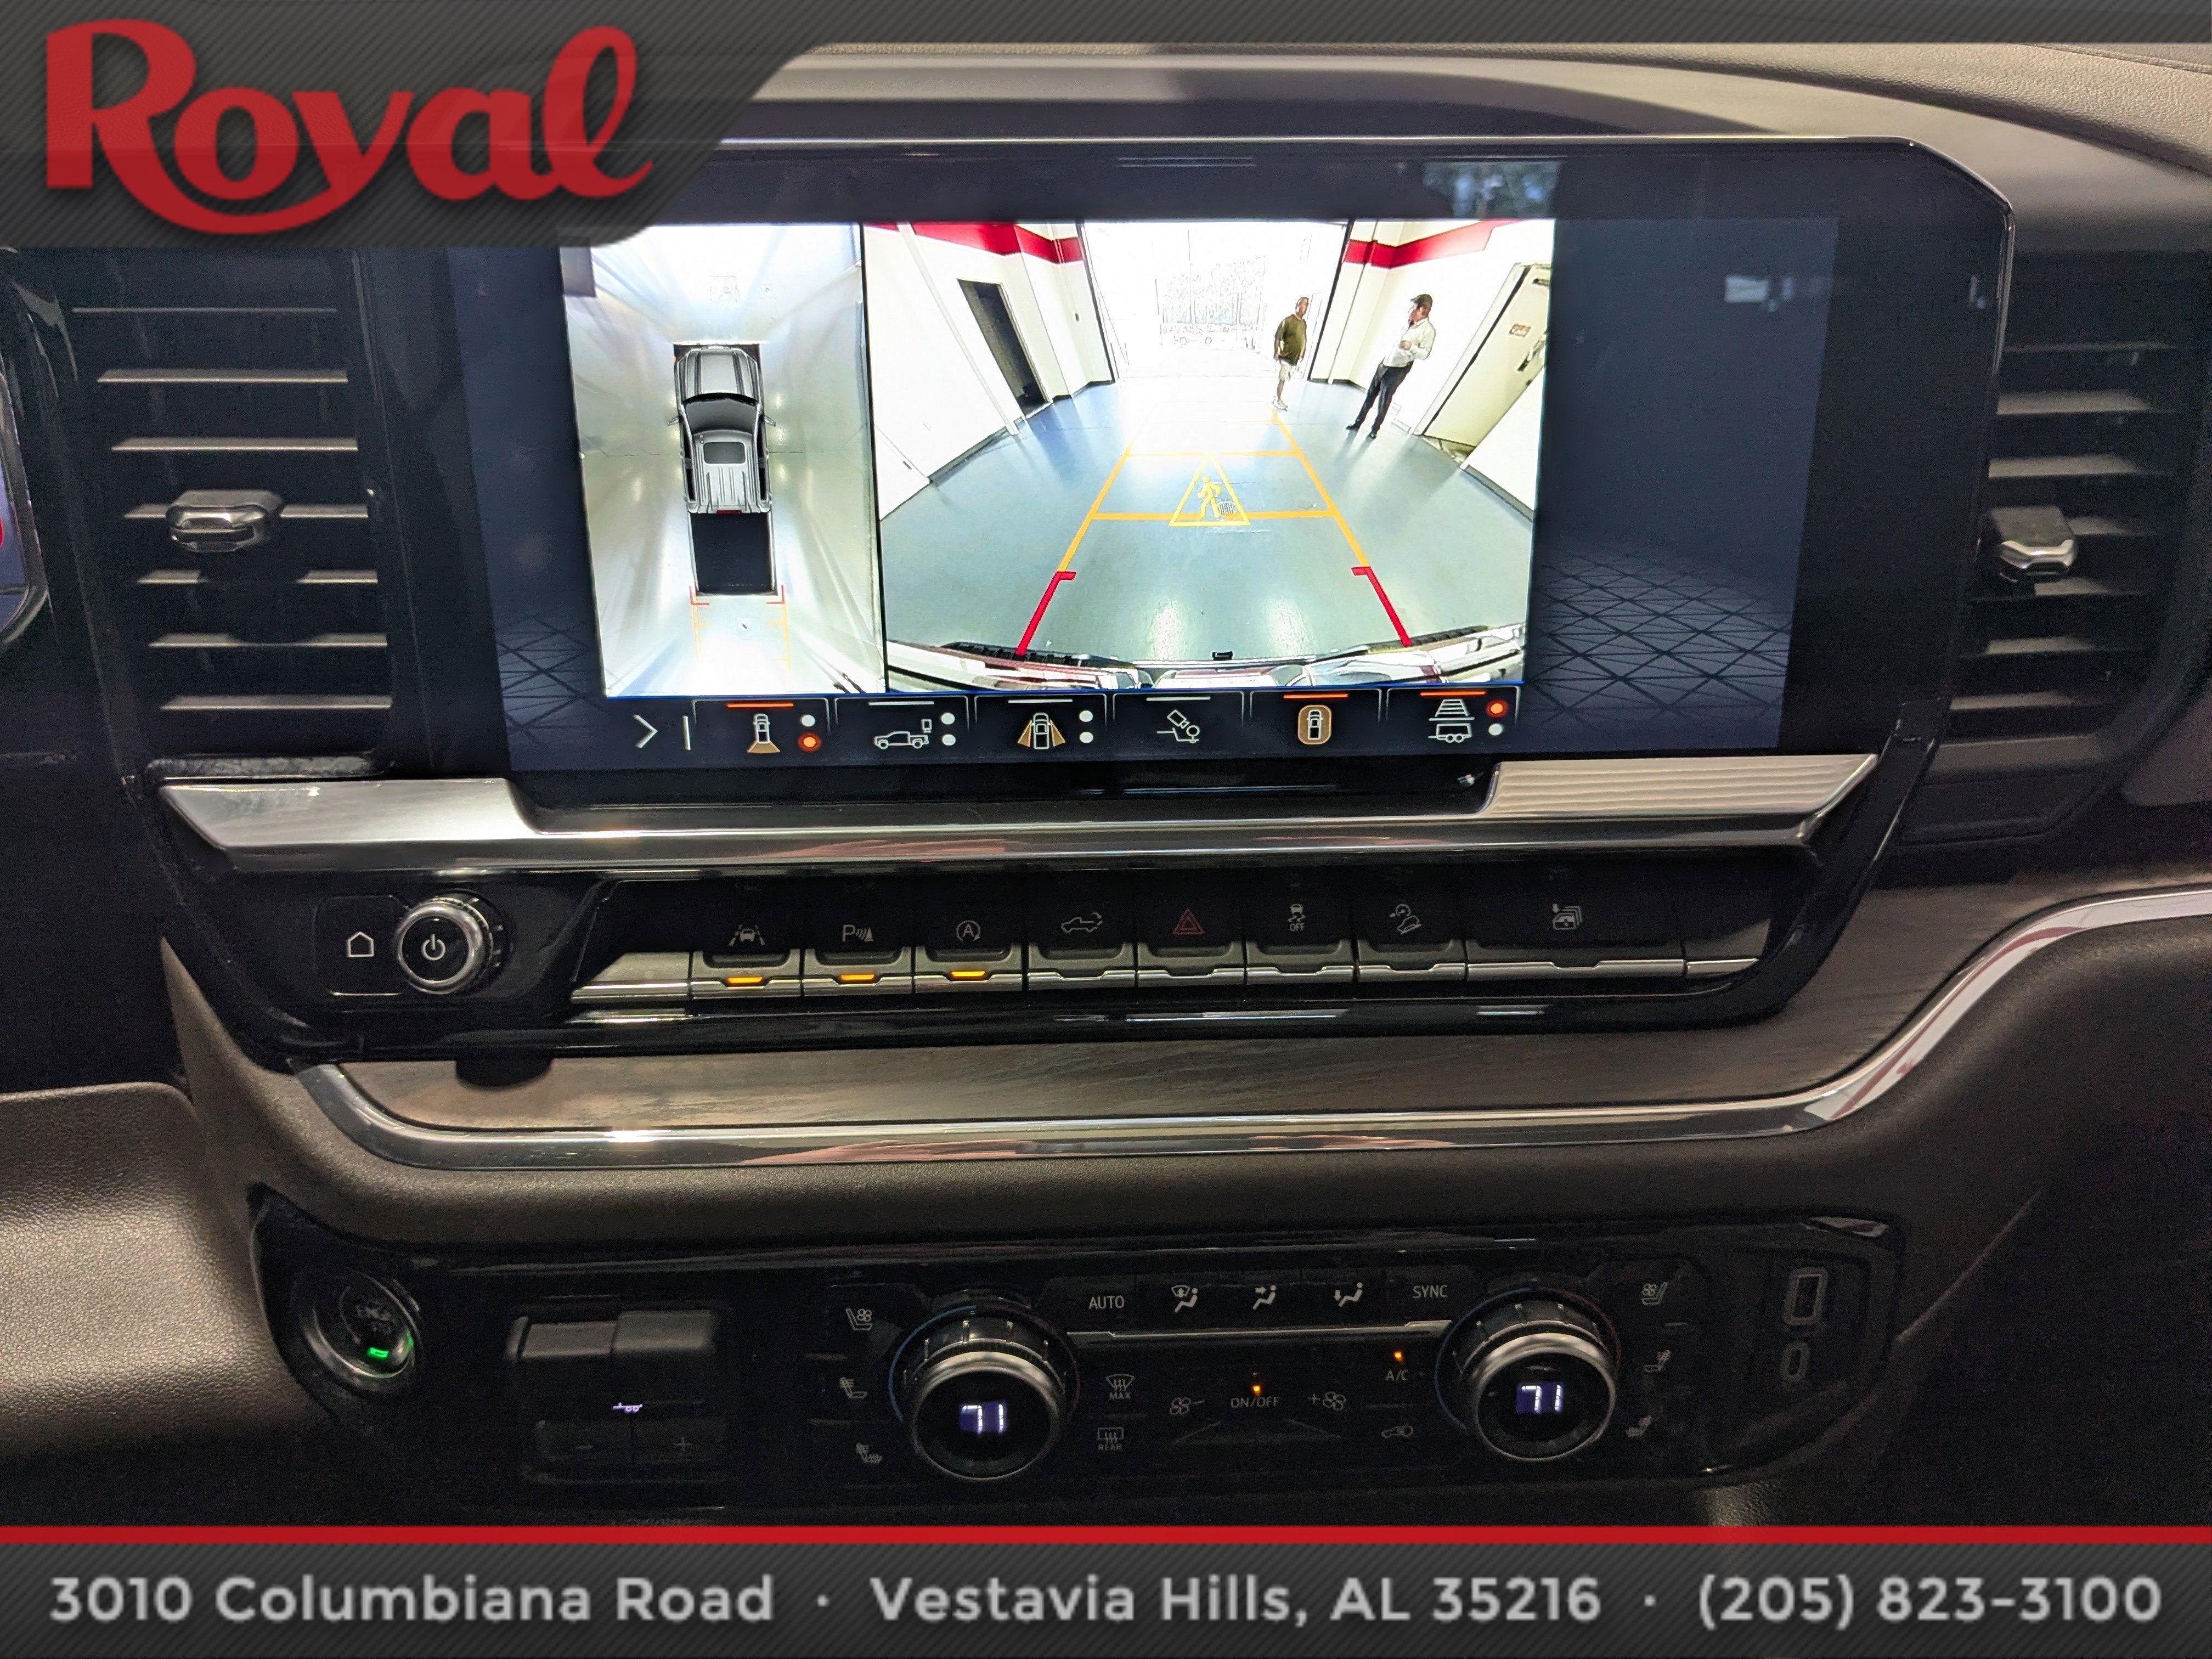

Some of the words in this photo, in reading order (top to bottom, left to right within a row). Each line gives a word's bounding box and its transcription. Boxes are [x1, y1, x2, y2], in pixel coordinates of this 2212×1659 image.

[1289, 923, 1305, 932] OFF
[1412, 1284, 1448, 1299] SYNC
[1088, 1296, 1125, 1309] AUTO
[1385, 1370, 1408, 1381] A/C
[1231, 1397, 1279, 1408] ON/OFF
[1521, 1385, 1562, 1413] 71
[962, 1404, 1004, 1434] 71
